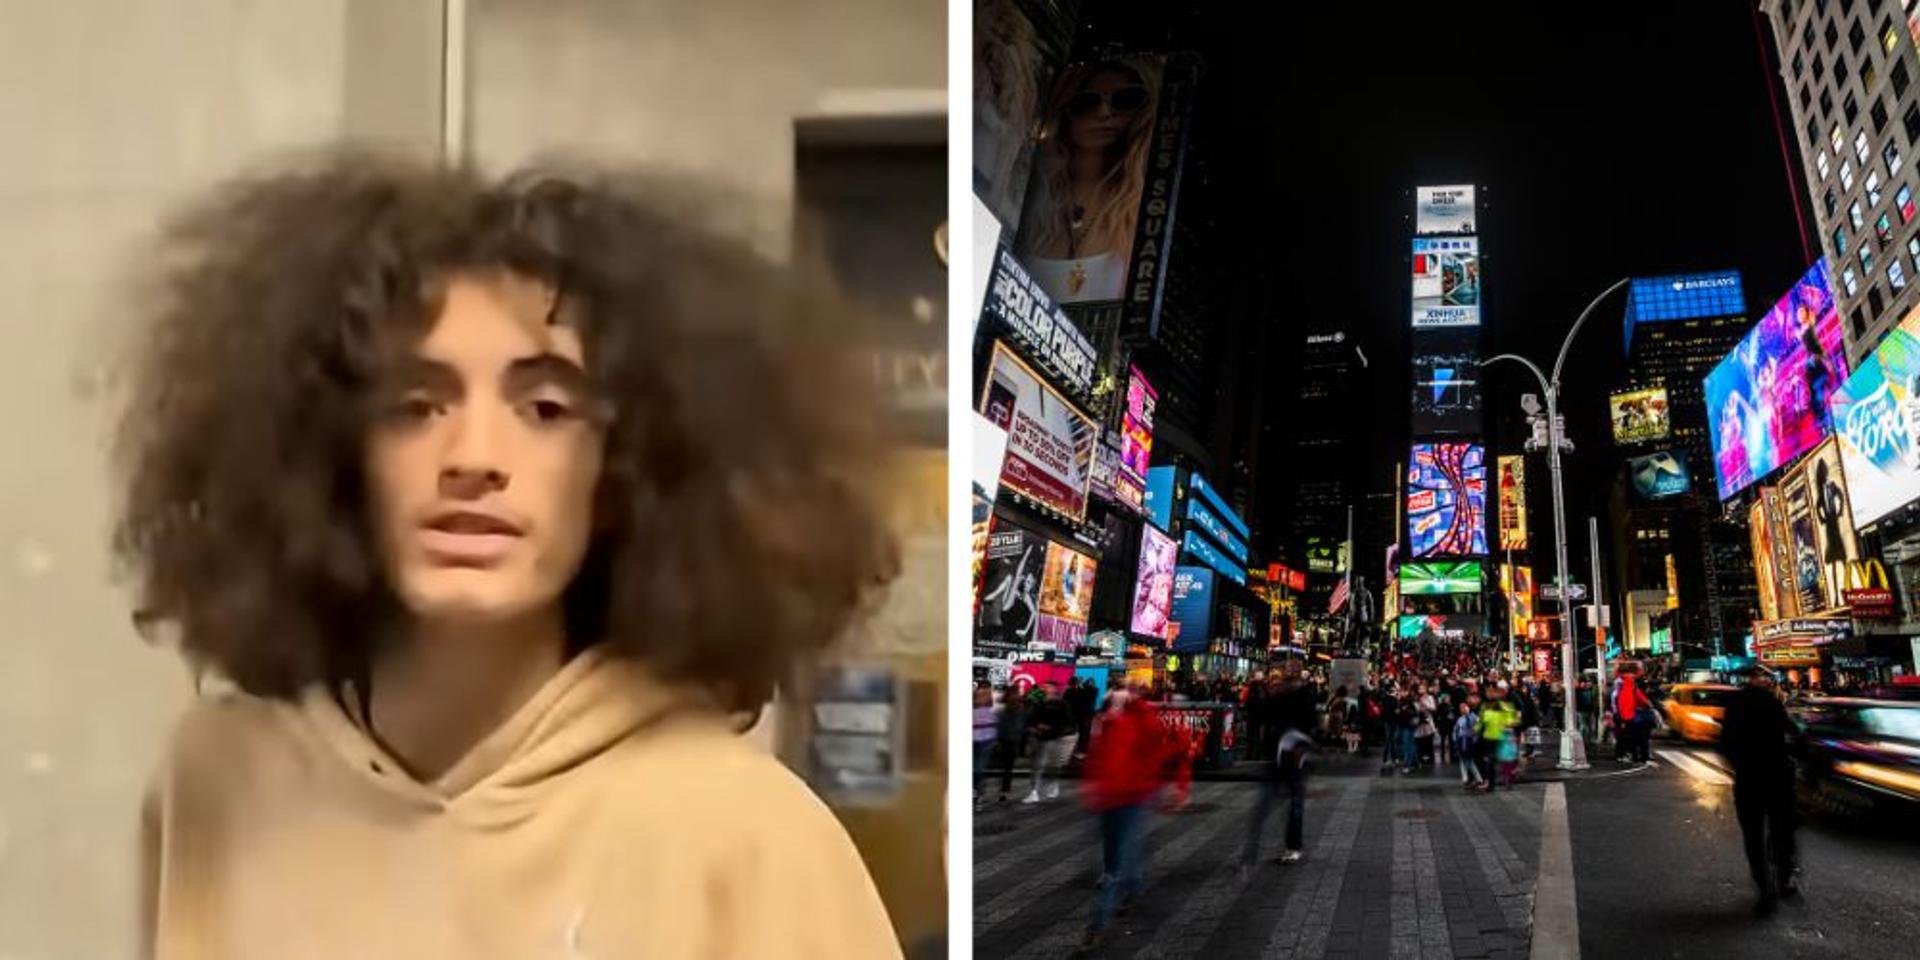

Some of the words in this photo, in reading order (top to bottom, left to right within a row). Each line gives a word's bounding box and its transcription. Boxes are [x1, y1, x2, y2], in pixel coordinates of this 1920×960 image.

[1134, 178, 1167, 301] SQUARE
[1686, 277, 1735, 289] BARCLAYS
[1426, 308, 1465, 319] XINHUA
[1005, 278, 1054, 347] COLOR
[1051, 324, 1096, 388] PURPLE
[1015, 419, 1026, 434] UP
[1028, 428, 1039, 443] TO
[1011, 432, 1022, 446] IN
[1034, 448, 1069, 477] SECONDS
[1770, 494, 1792, 589] PALACE
[1019, 651, 1045, 662] NYC
